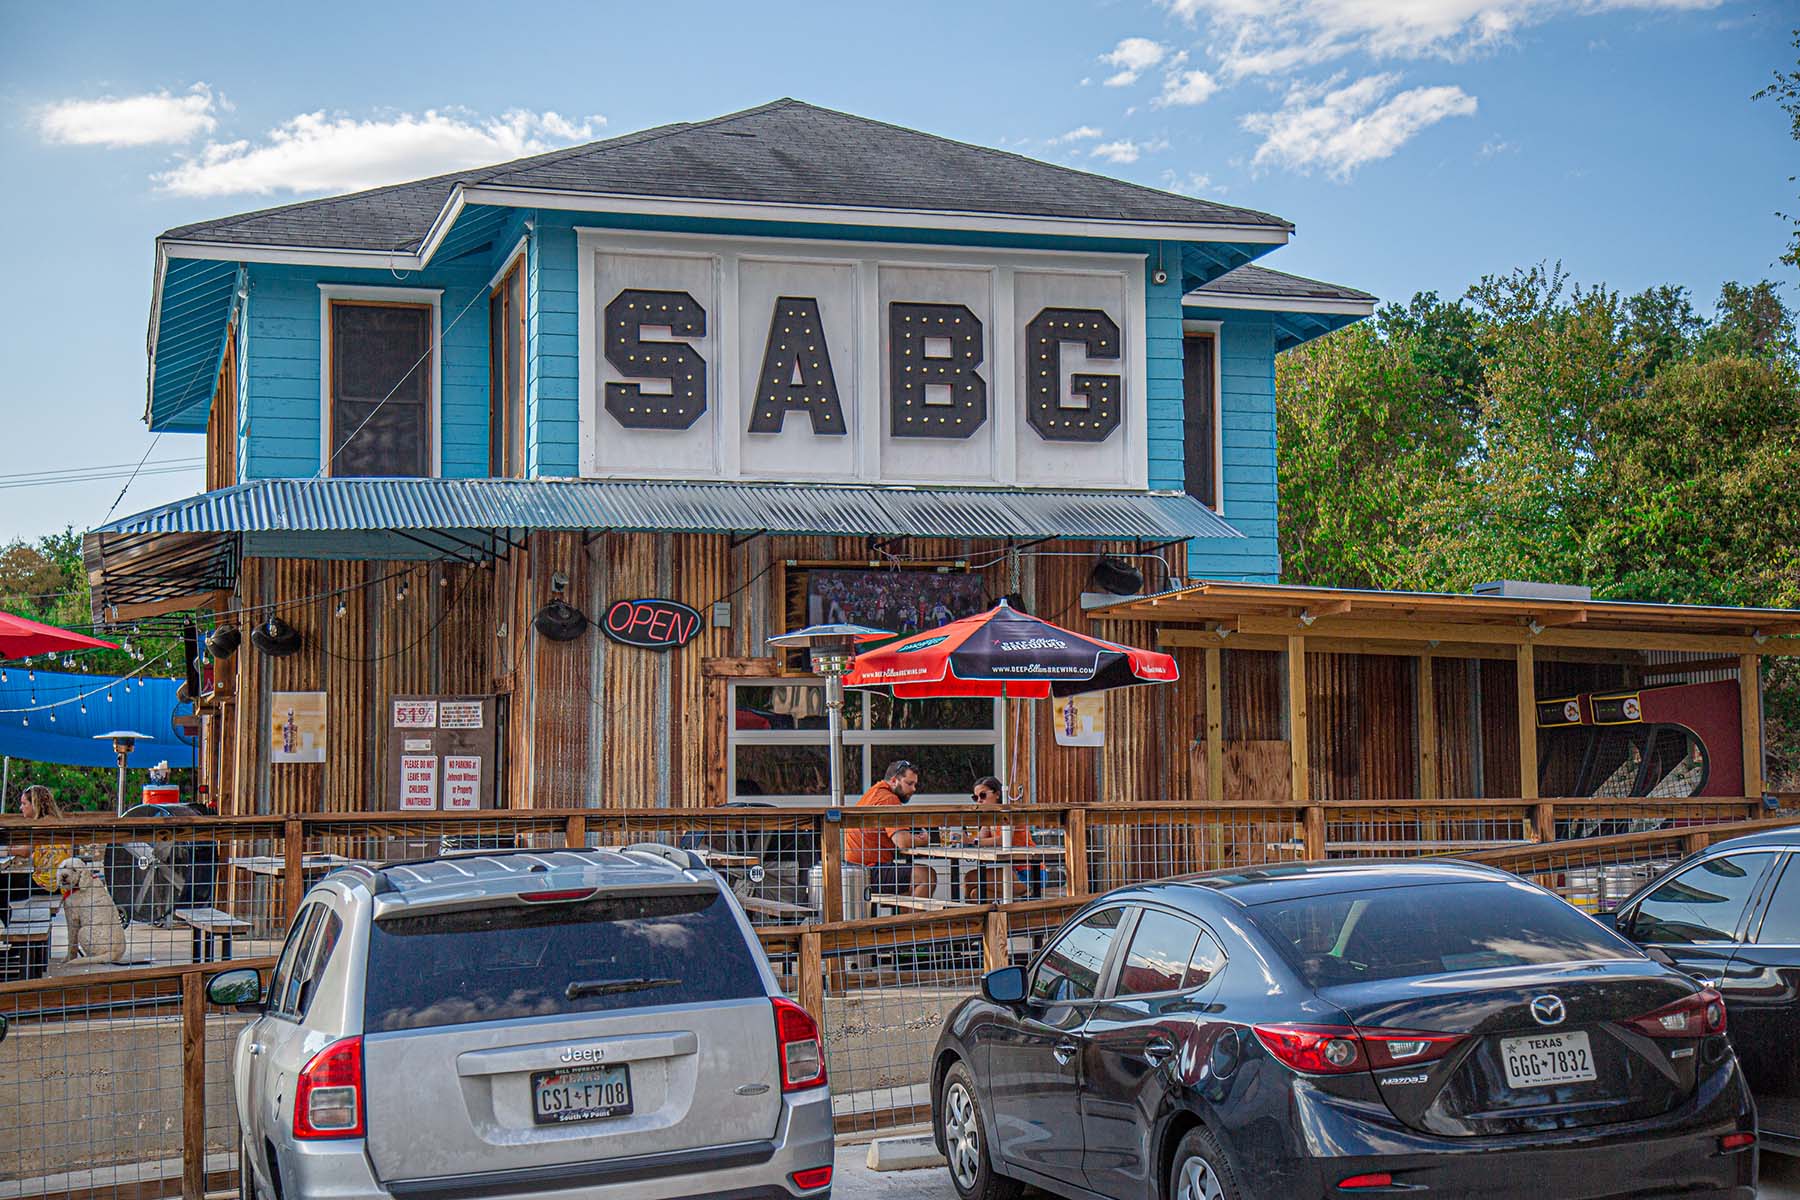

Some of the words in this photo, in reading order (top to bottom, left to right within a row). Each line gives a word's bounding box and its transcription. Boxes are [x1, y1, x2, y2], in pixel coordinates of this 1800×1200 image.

[604, 287, 1121, 441] SABG
[608, 601, 694, 644] OPEN
[397, 706, 434, 724] 51%
[404, 760, 419, 769] PLEASE
[420, 760, 426, 769] DO
[427, 760, 435, 769] NOT
[449, 760, 455, 769] NO
[456, 760, 472, 769] PARKING
[407, 773, 419, 781] LEAVE
[420, 773, 431, 781] YOUR
[447, 773, 462, 781] Jehovah
[463, 773, 478, 781] Witness
[409, 785, 429, 794] CHILDREN
[457, 785, 472, 795] Property
[406, 798, 431, 806] UNATTENDED
[453, 798, 461, 806] Next
[462, 798, 471, 806] Door
[1528, 1038, 1563, 1049] TEXAS
[561, 1048, 605, 1062] Jeep
[560, 1071, 600, 1084] TEXAS
[559, 1114, 581, 1122] South
